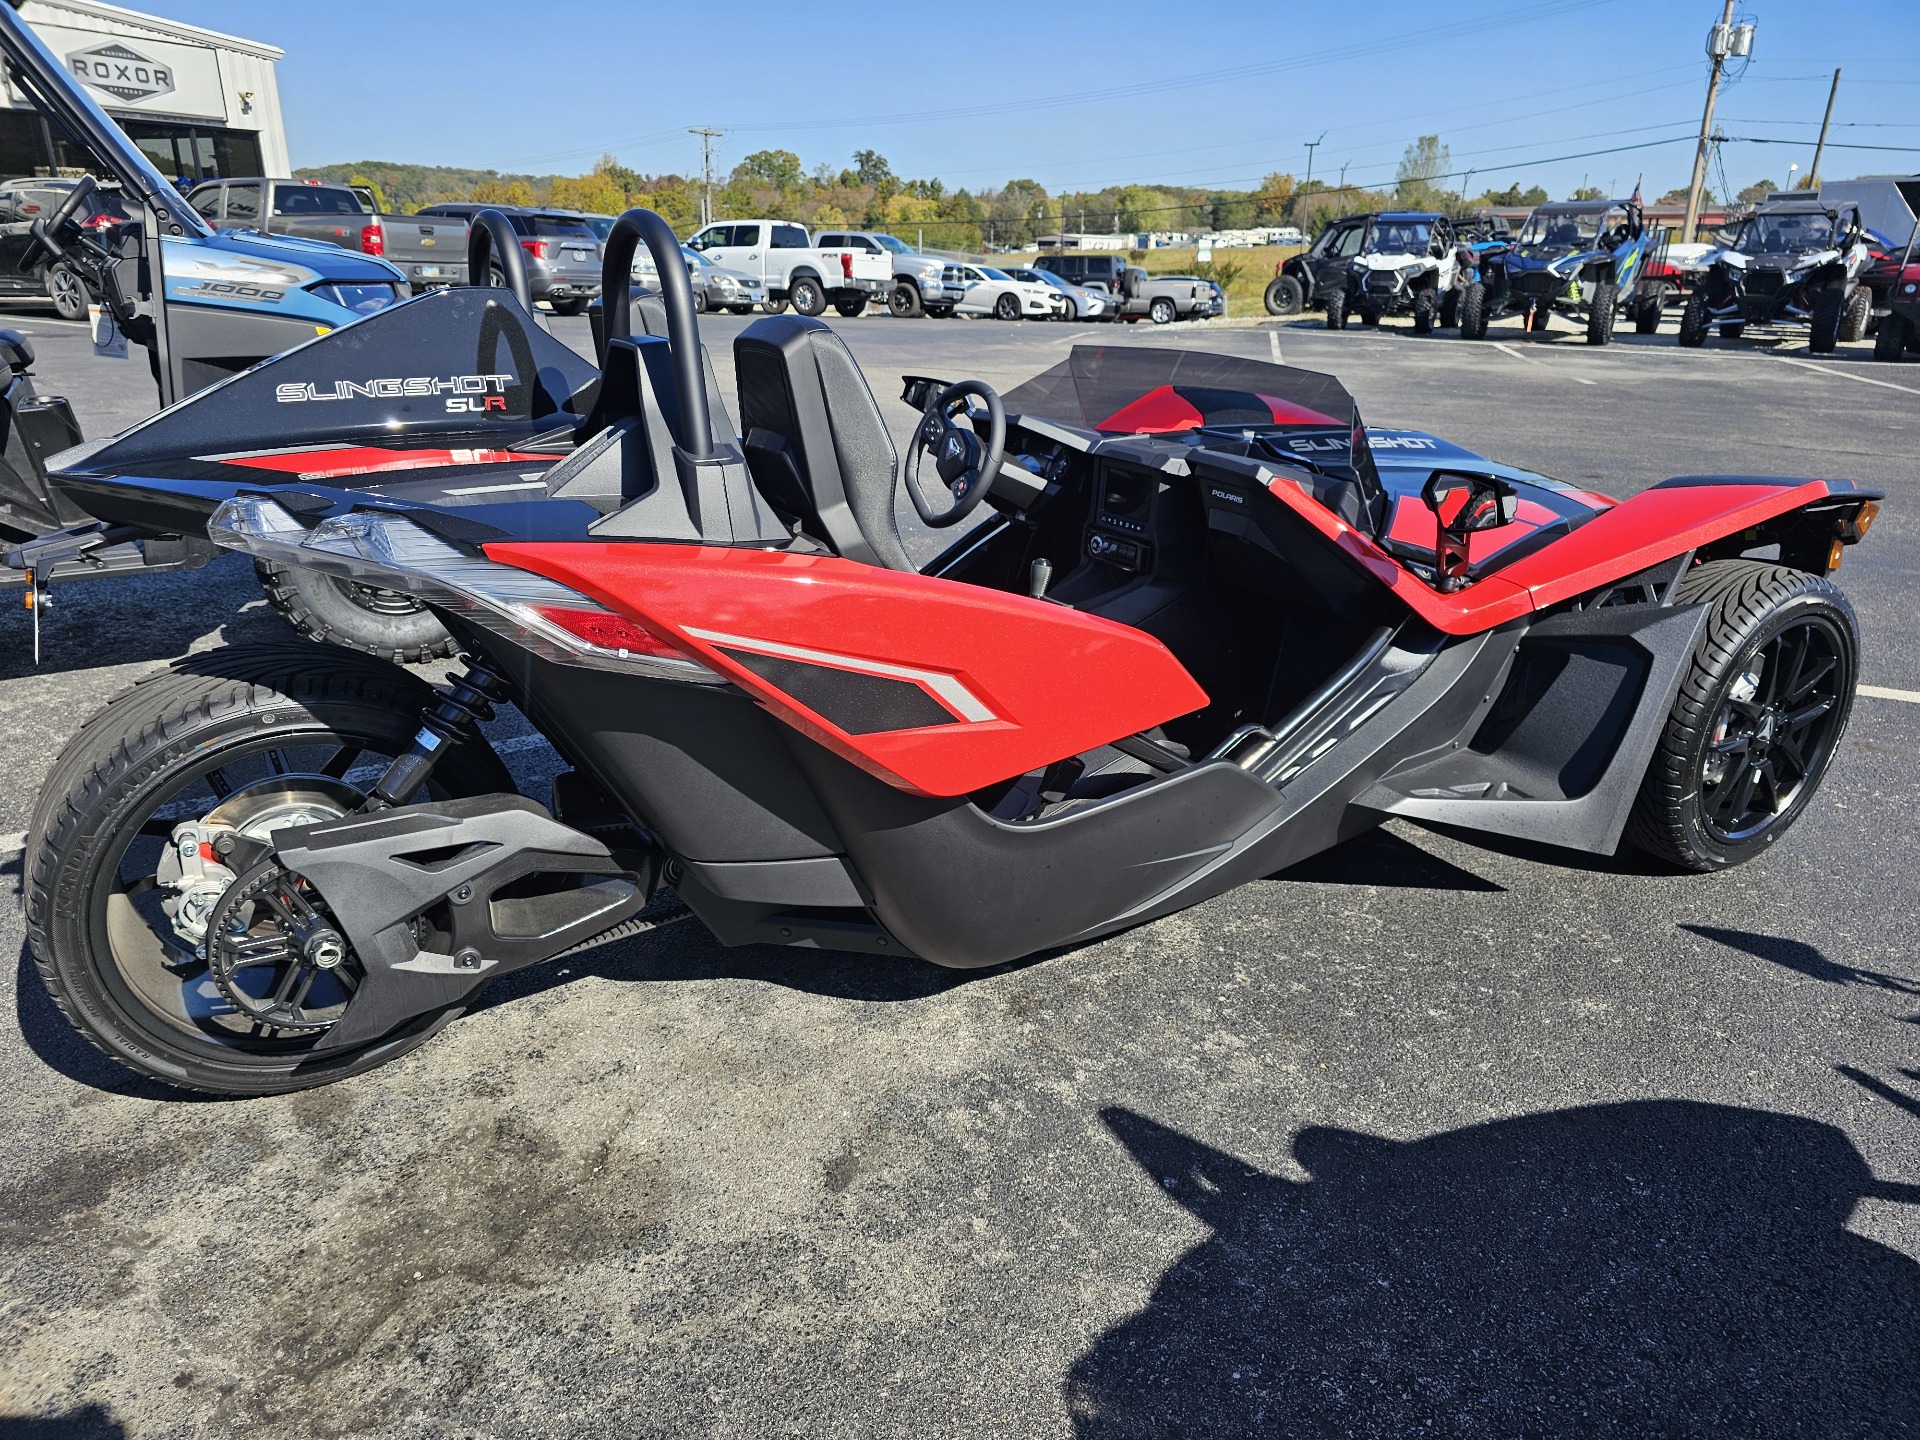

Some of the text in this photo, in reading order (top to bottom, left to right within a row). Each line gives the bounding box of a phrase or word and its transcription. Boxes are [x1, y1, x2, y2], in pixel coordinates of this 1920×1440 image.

[101, 50, 137, 60] MAHINDRA
[72, 59, 169, 87] ROXOR
[109, 86, 143, 96] OFFROAD
[201, 282, 286, 300] 1000
[275, 375, 513, 403] SLINGSHOT
[445, 397, 507, 413] SLR
[1211, 489, 1244, 504] POLARIS
[99, 738, 190, 819] RADIAL
[55, 834, 97, 919] KENDA
[115, 1032, 151, 1060] RADIAL
